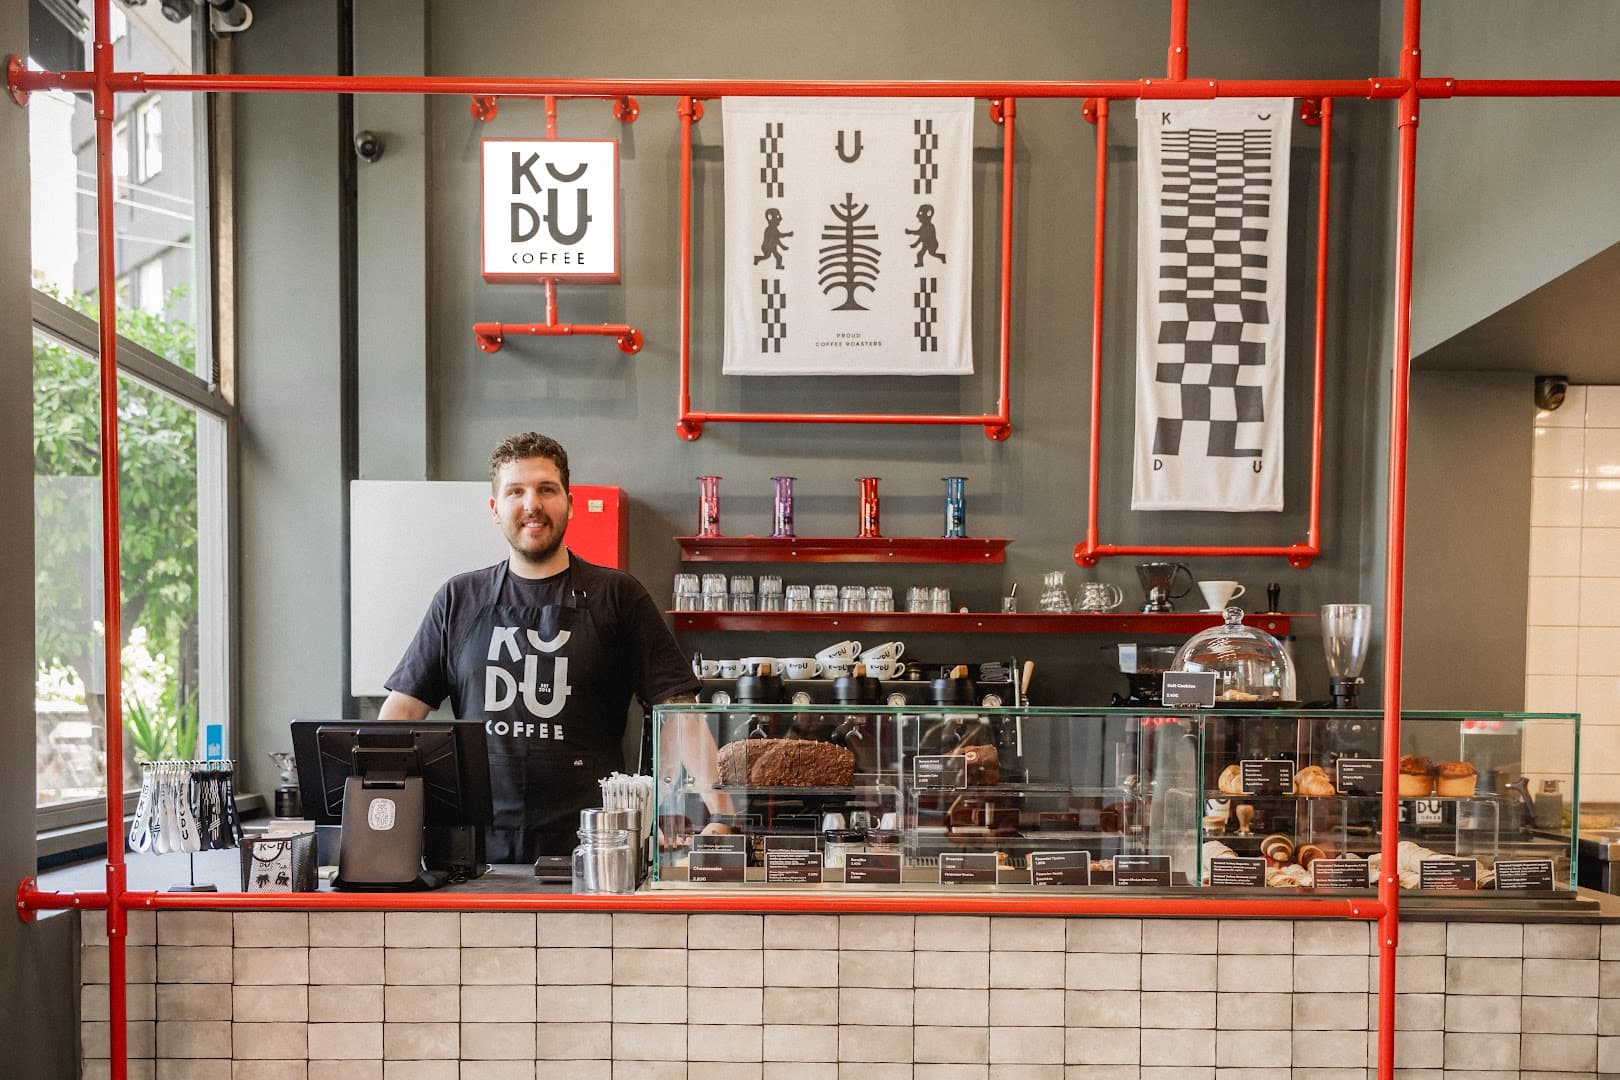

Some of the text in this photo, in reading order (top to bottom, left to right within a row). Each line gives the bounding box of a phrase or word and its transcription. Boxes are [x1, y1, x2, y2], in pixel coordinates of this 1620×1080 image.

[1161, 112, 1171, 125] K
[835, 130, 864, 164] U
[512, 252, 585, 265] COFFEE
[1153, 459, 1263, 473] D U
[485, 719, 564, 741] COFFEE
